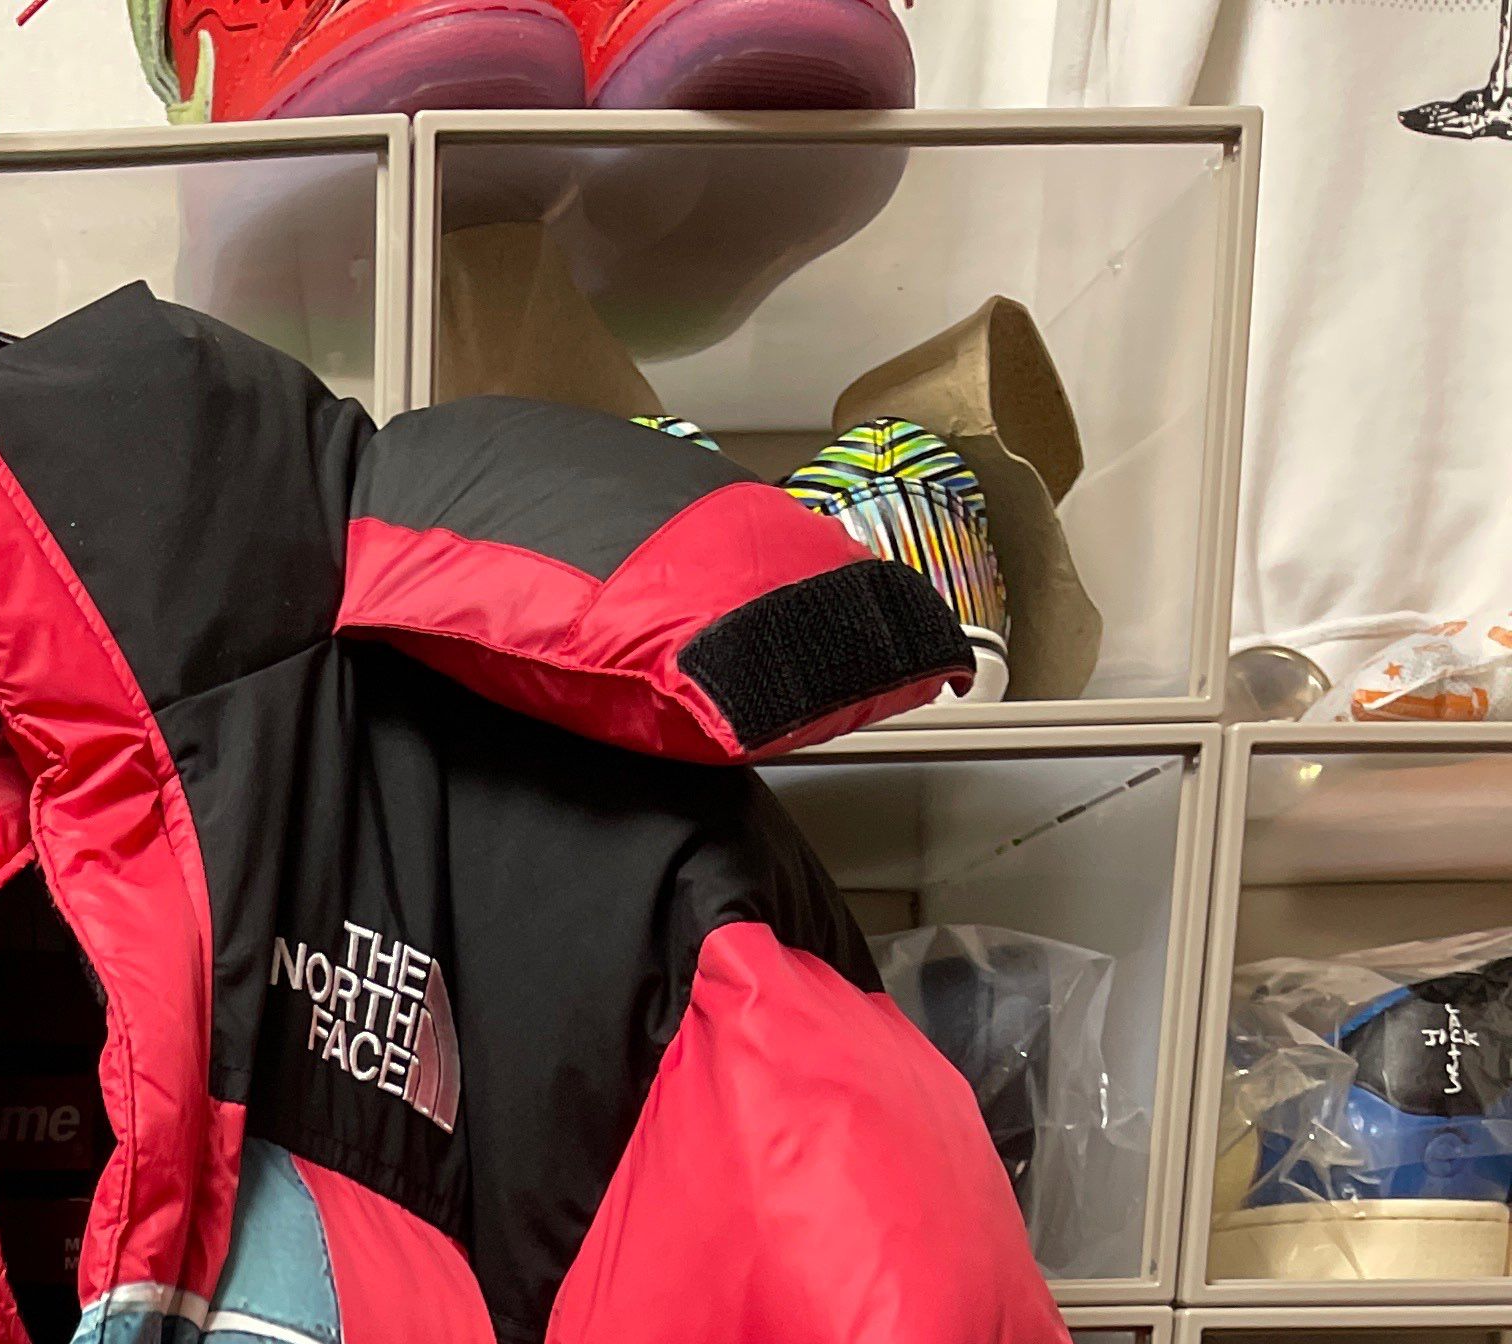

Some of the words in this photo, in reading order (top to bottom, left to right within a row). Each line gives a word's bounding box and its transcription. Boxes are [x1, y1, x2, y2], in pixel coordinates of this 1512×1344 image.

[270, 936, 419, 1048] NORTH
[344, 920, 431, 1000] THE
[308, 1004, 407, 1096] FACE
